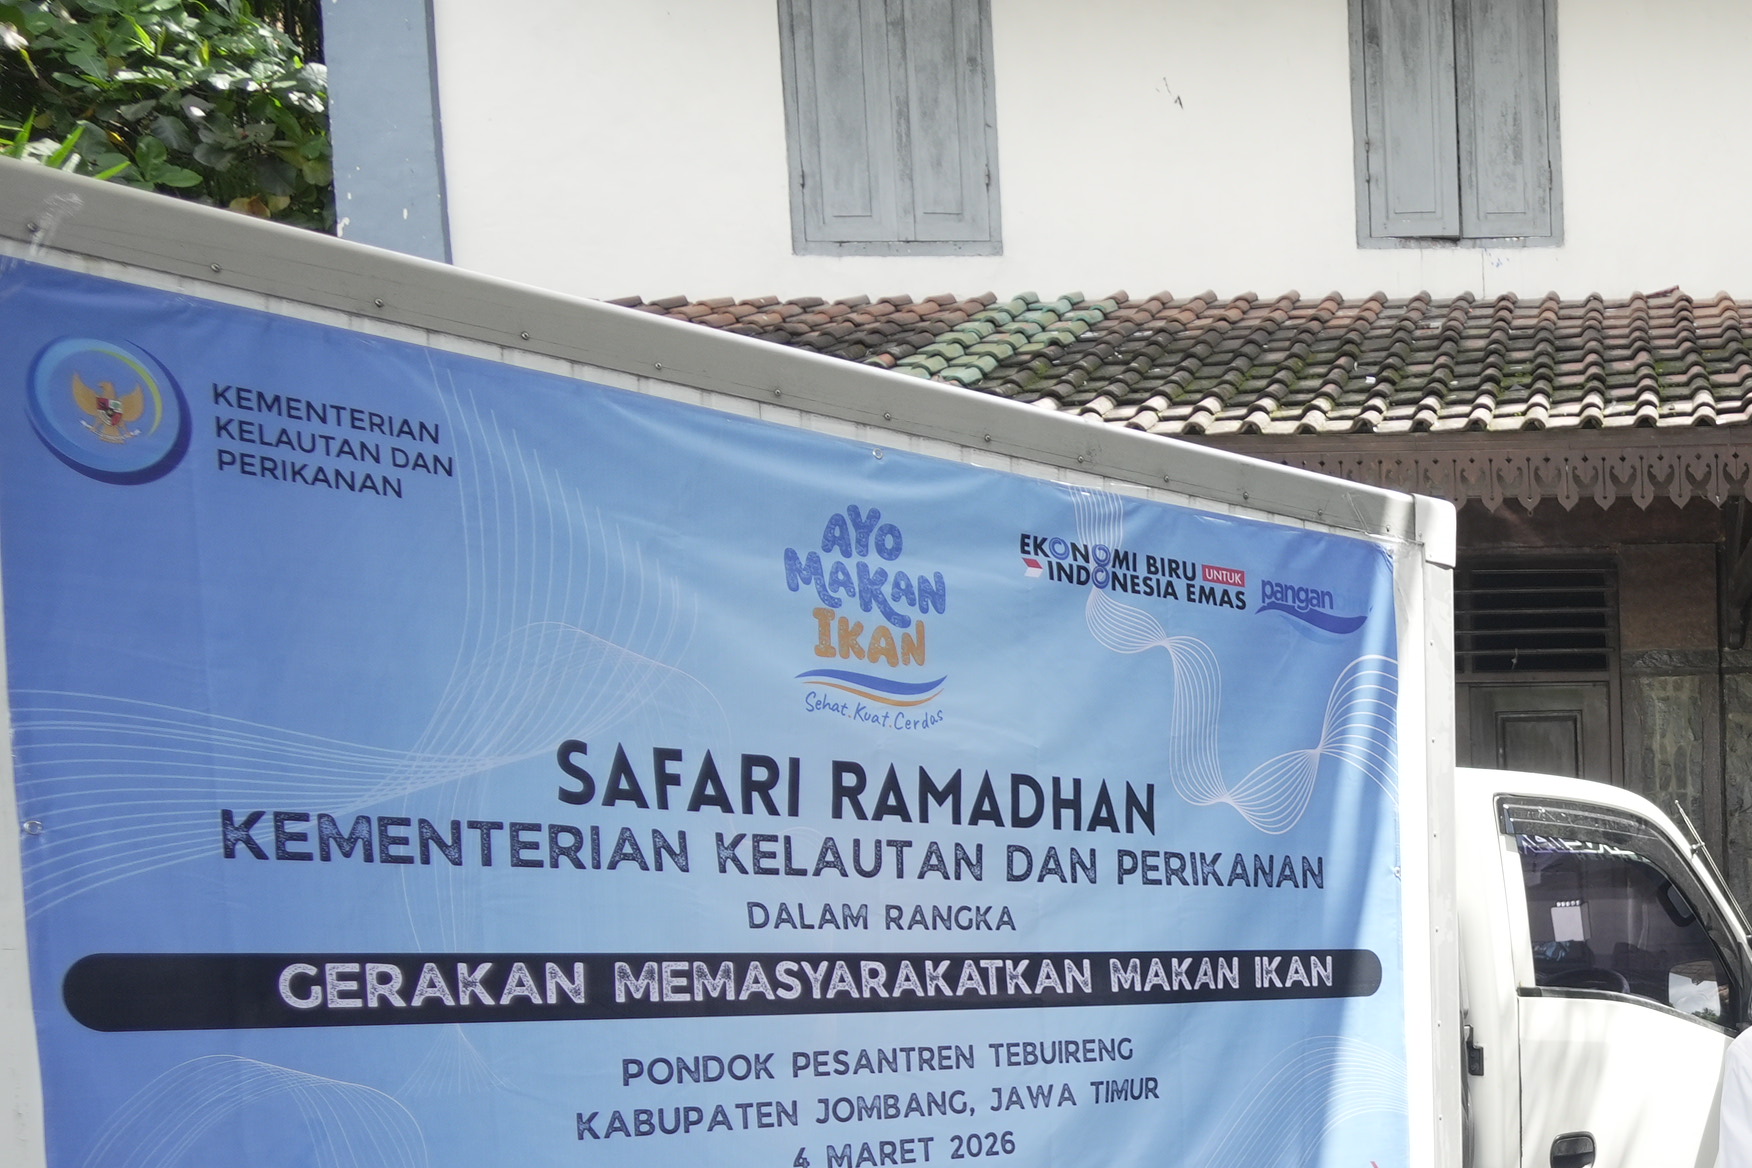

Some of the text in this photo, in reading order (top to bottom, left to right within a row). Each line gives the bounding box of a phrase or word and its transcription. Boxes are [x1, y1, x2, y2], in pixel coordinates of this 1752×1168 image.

[211, 382, 440, 444] KEMENTERIAN
[214, 416, 454, 477] KELAUTAN DAN
[217, 449, 403, 498] PERIKANAN
[821, 504, 903, 561] AYO
[1019, 532, 1243, 585] EKONOMI BIRU UNTUK
[784, 547, 946, 629] MAKAN
[1047, 559, 1247, 610] INDONESIA EMAS
[1260, 578, 1334, 613] pangan
[812, 607, 926, 668] IKAN
[556, 739, 1156, 836] SAFARI RAMADHAN
[220, 808, 1325, 890] KEMENTERIAN KELAUTAN DAN PERIKANAN
[747, 900, 1017, 932] DALAM RANGKA
[278, 954, 1334, 1010] GERAKAN MEMASYARAKATKAN MAKAN IKAN
[622, 1037, 1134, 1087] PONDOK PESANTREN TEBUIRENG
[576, 1076, 1160, 1141] KABUPATEN JOMBANG, JAWA TIMUR
[950, 1130, 1016, 1161] 2026
